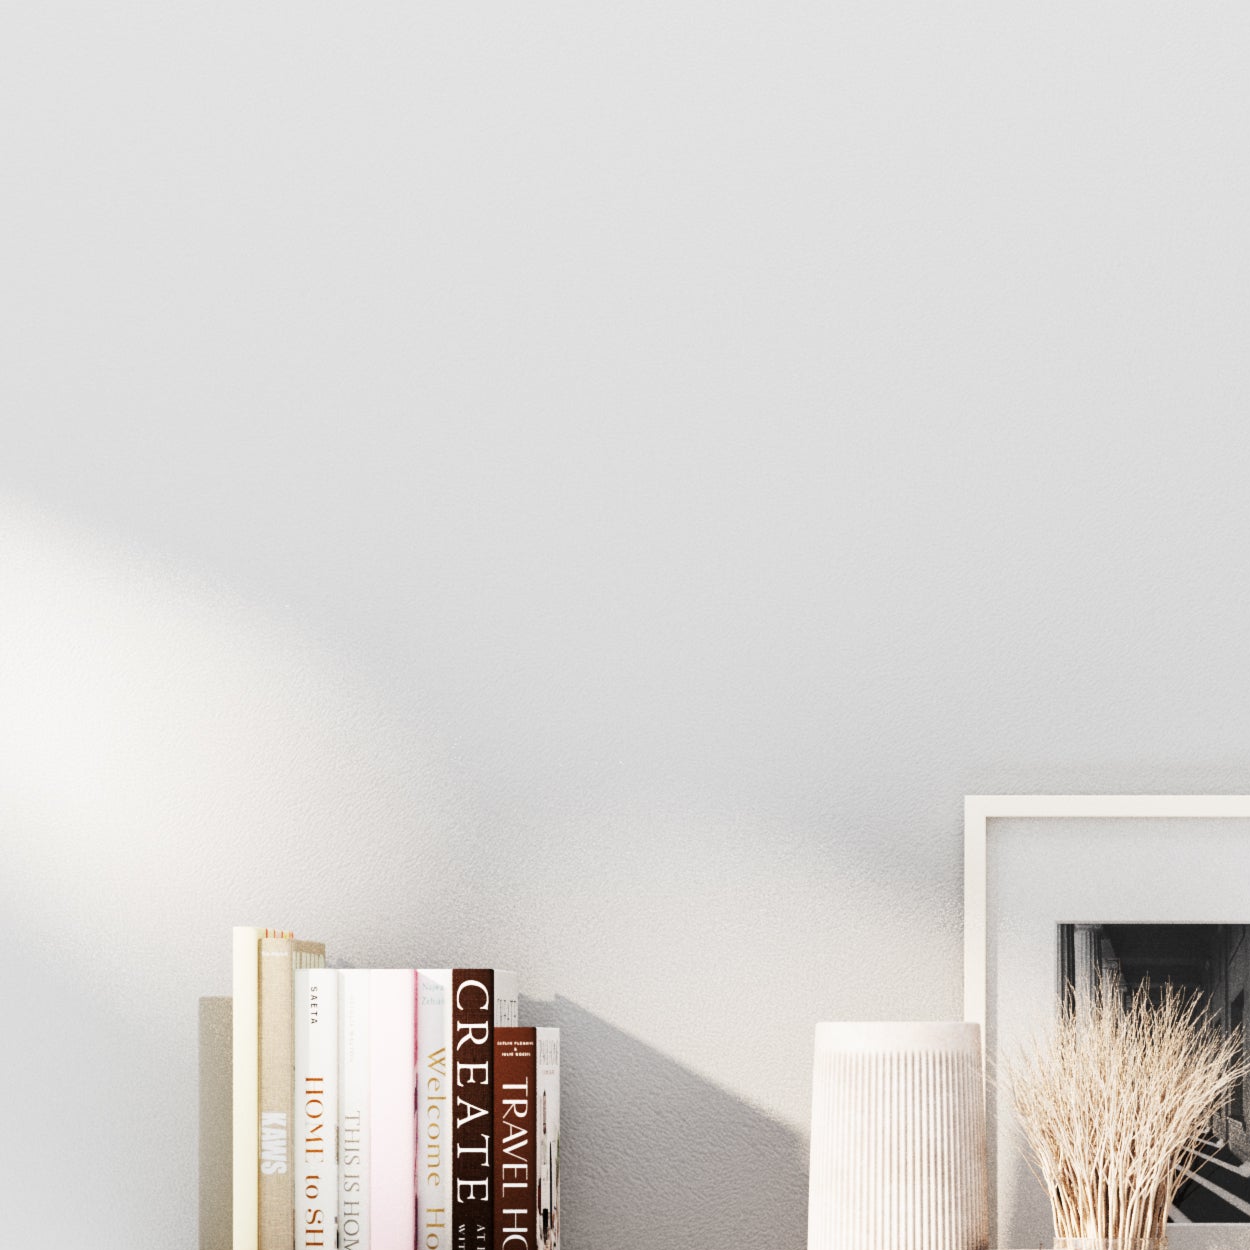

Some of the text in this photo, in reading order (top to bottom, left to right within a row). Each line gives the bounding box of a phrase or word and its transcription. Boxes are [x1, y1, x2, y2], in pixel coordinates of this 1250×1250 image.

[310, 987, 318, 1024] SAETA
[428, 1047, 446, 1186] Welcome
[456, 980, 489, 1204] CREATE
[261, 1113, 287, 1175] KAWS
[305, 1077, 324, 1166] HOME
[344, 1111, 360, 1166] THIS
[502, 1077, 529, 1197] TRAVEL
[304, 1176, 320, 1199] to
[344, 1171, 360, 1192] IS
[476, 1225, 486, 1242] AT
